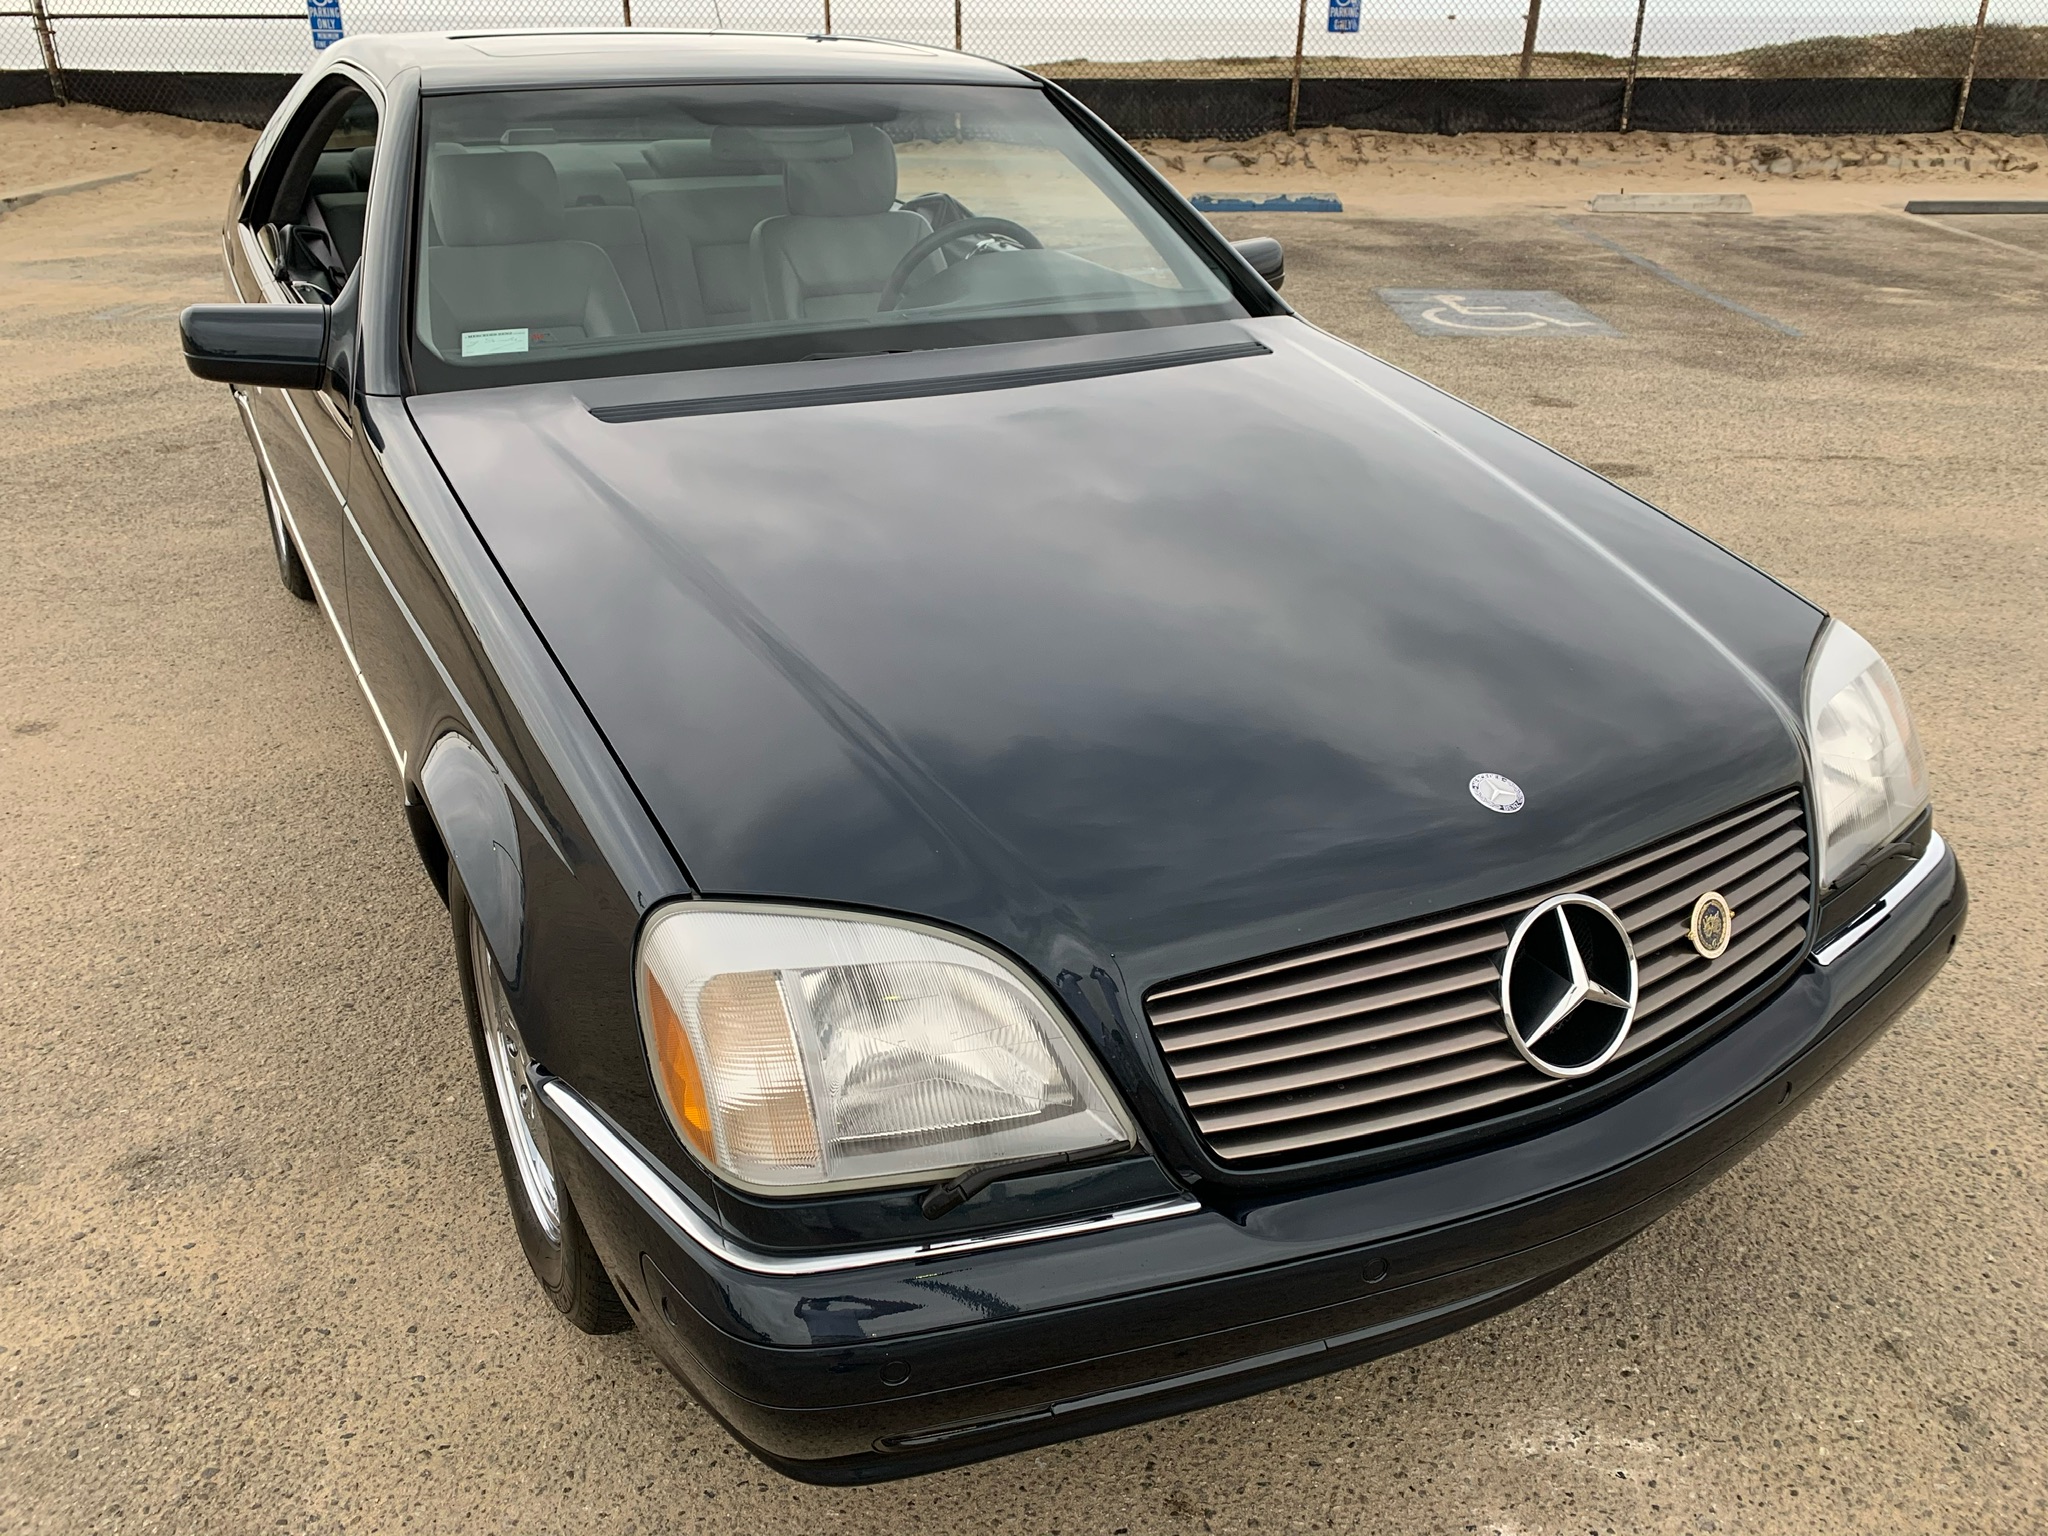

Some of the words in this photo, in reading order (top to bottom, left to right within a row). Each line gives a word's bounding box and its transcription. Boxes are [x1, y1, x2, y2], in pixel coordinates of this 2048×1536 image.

[308, 6, 340, 18] PARKING
[1330, 6, 1360, 18] PARKING
[317, 18, 336, 29] ONLY
